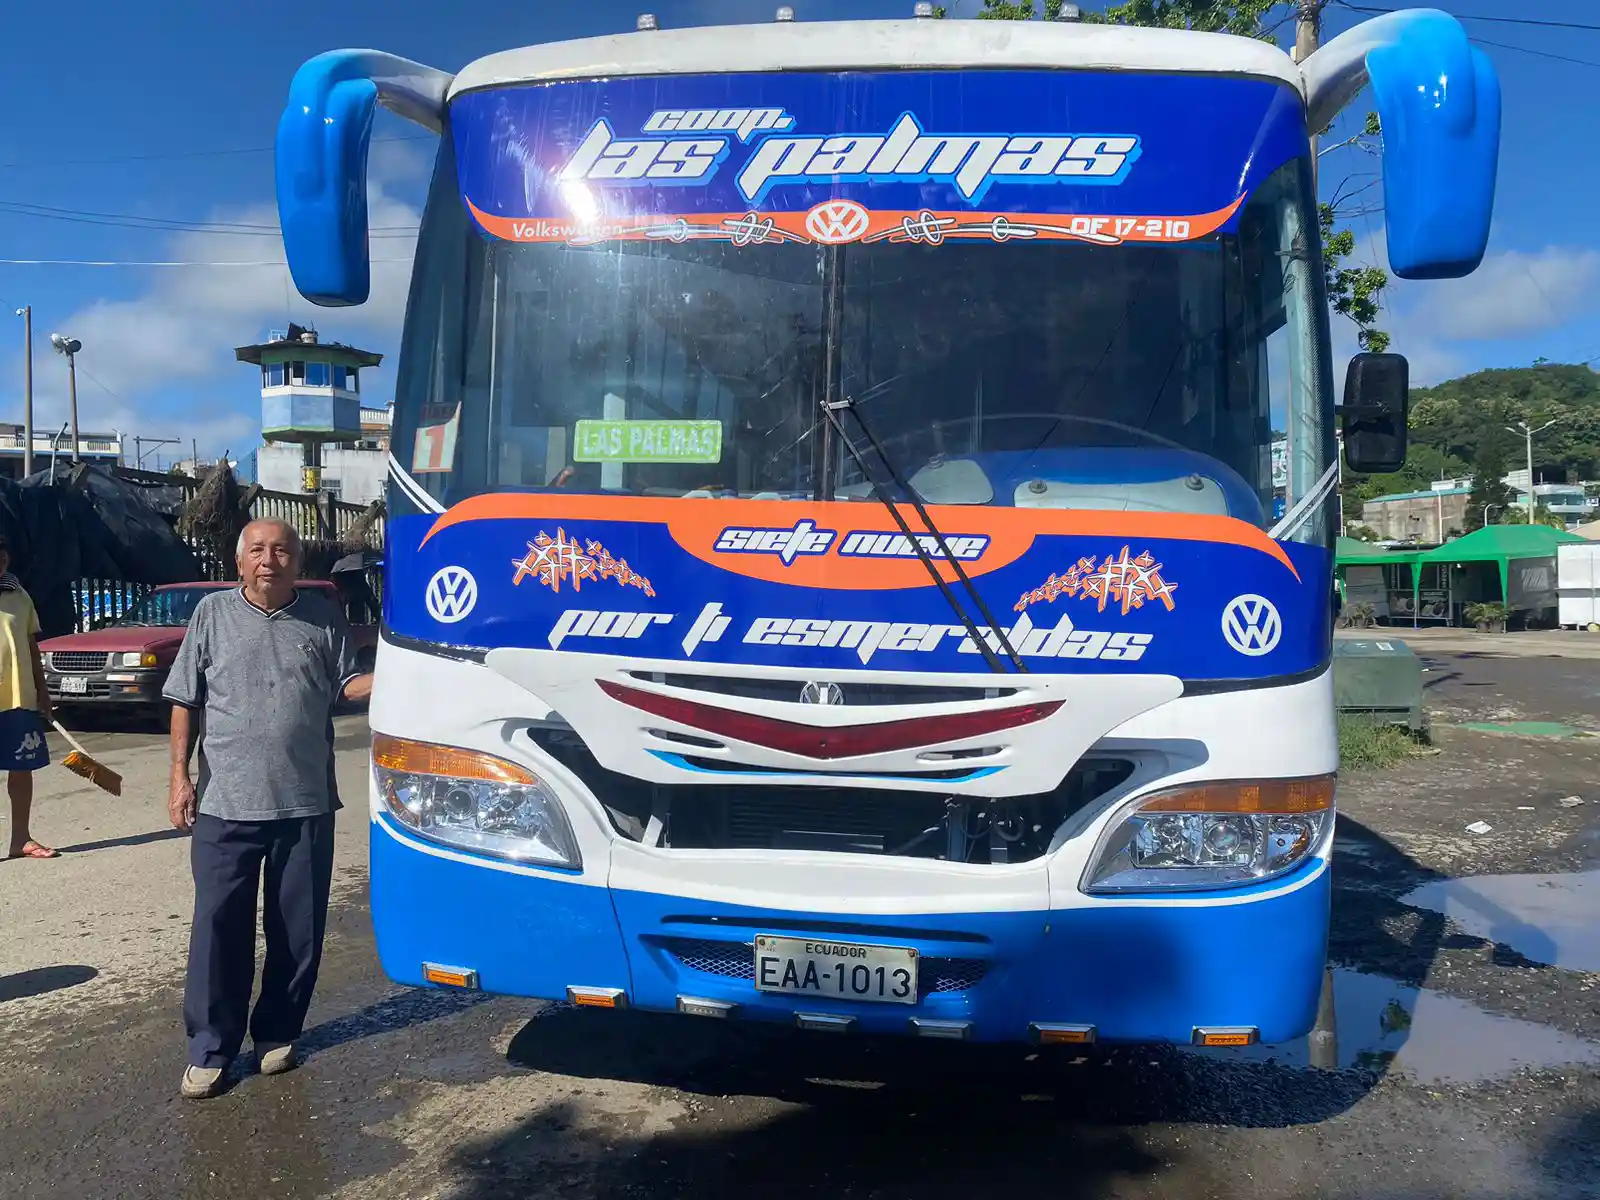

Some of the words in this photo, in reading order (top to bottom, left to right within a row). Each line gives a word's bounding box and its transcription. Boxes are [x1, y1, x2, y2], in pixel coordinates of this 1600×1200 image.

[737, 112, 1138, 201] palmas
[1114, 218, 1190, 238] 17-210
[583, 426, 624, 456] LAS
[628, 427, 715, 456] PALMAS
[548, 609, 674, 651] por
[681, 602, 733, 657] ti
[805, 943, 866, 959] ECUADOR
[760, 956, 911, 998] EAA-1013
